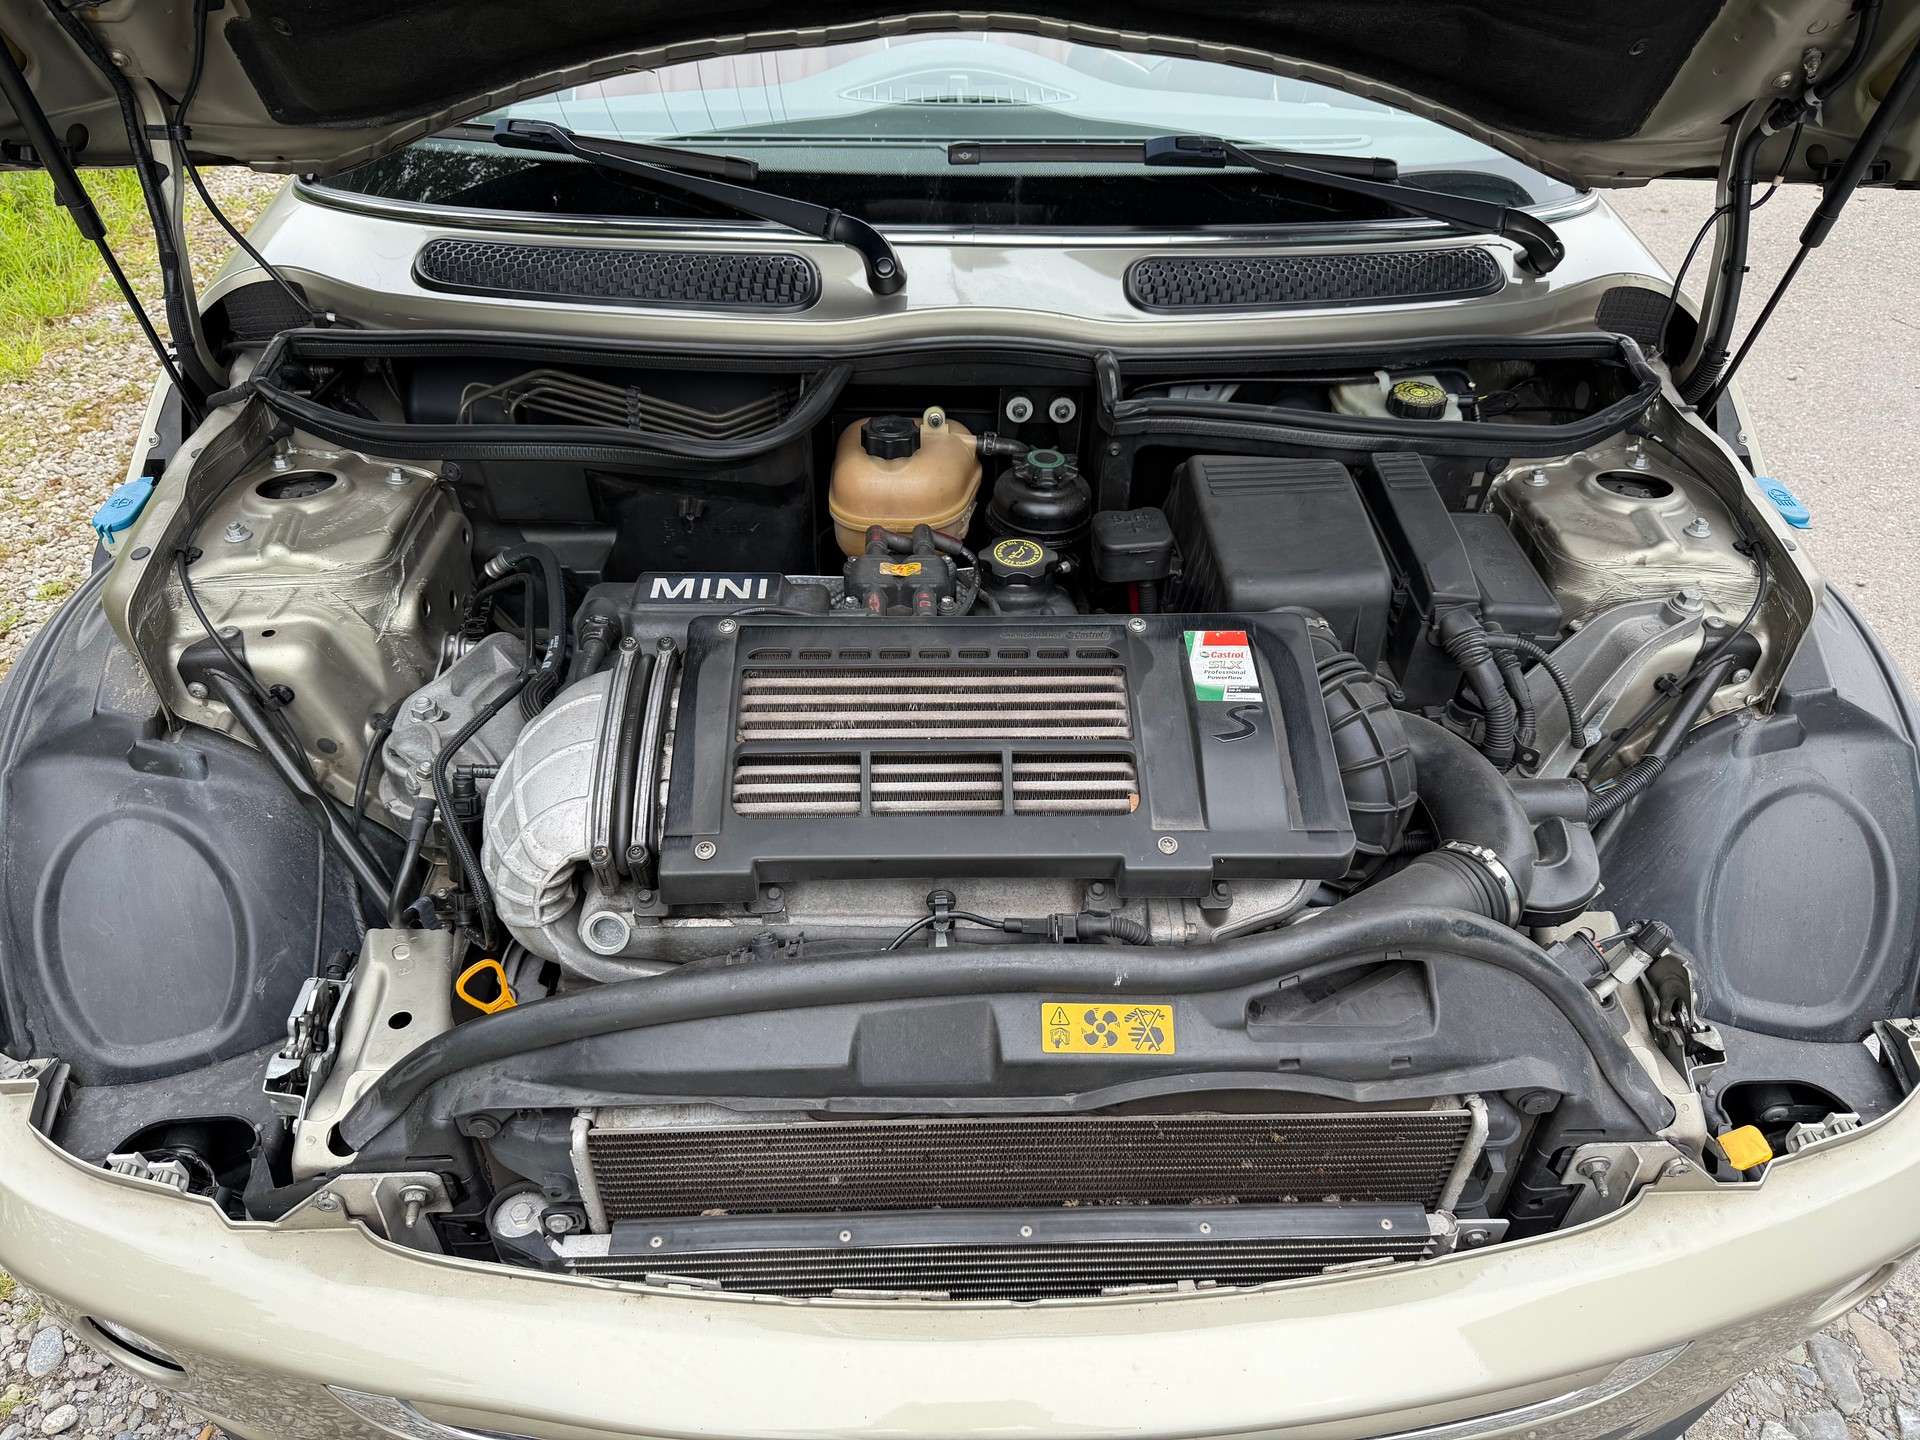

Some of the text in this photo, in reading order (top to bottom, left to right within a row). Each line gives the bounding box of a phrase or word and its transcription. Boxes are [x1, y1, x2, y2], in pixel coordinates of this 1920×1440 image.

[650, 577, 769, 599] MINI
[1074, 631, 1104, 639] Castrol
[1210, 651, 1244, 659] Castrol
[1208, 660, 1243, 669] SLX
